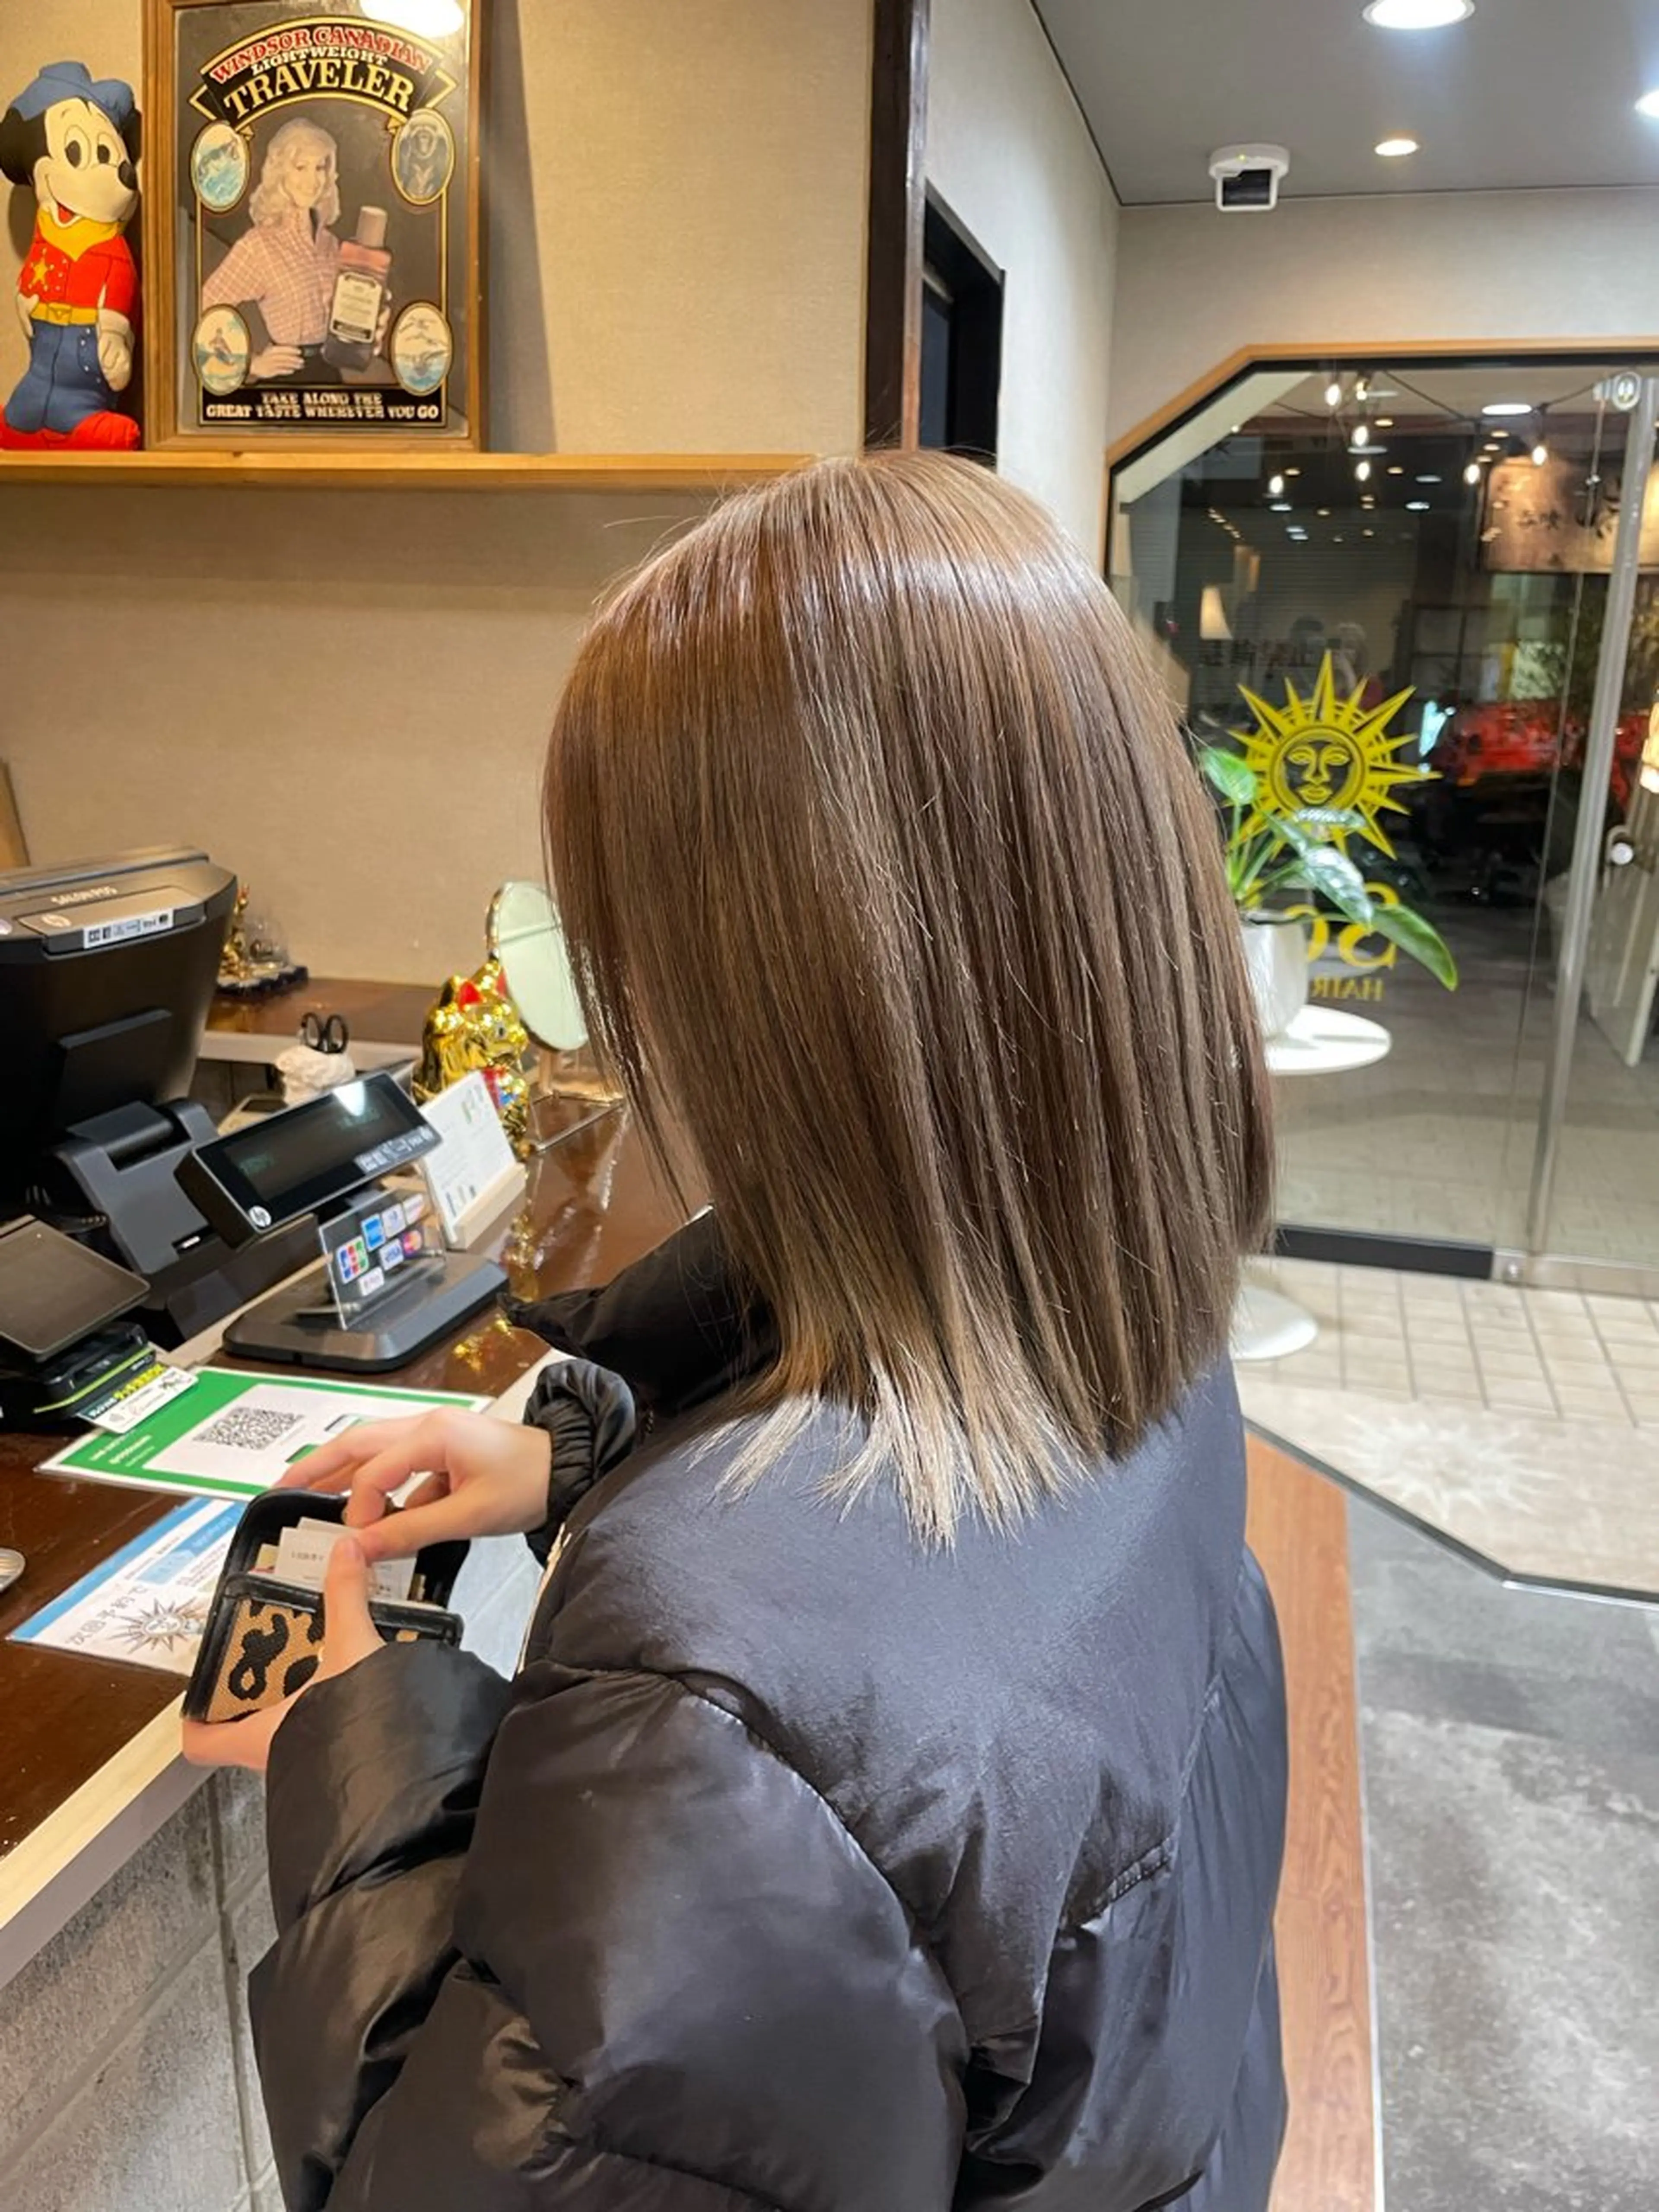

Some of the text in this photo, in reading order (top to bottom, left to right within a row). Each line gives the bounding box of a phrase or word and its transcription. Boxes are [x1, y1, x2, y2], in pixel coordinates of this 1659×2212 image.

[210, 25, 433, 84] WINDSOR CANADIAN
[251, 45, 389, 76] LIGHTWEIGHT
[224, 59, 415, 119] TRAVELER
[206, 404, 439, 419] GREAT TASTE WHEREVER YOU GO
[262, 392, 382, 405] TAKE ALONG THE
